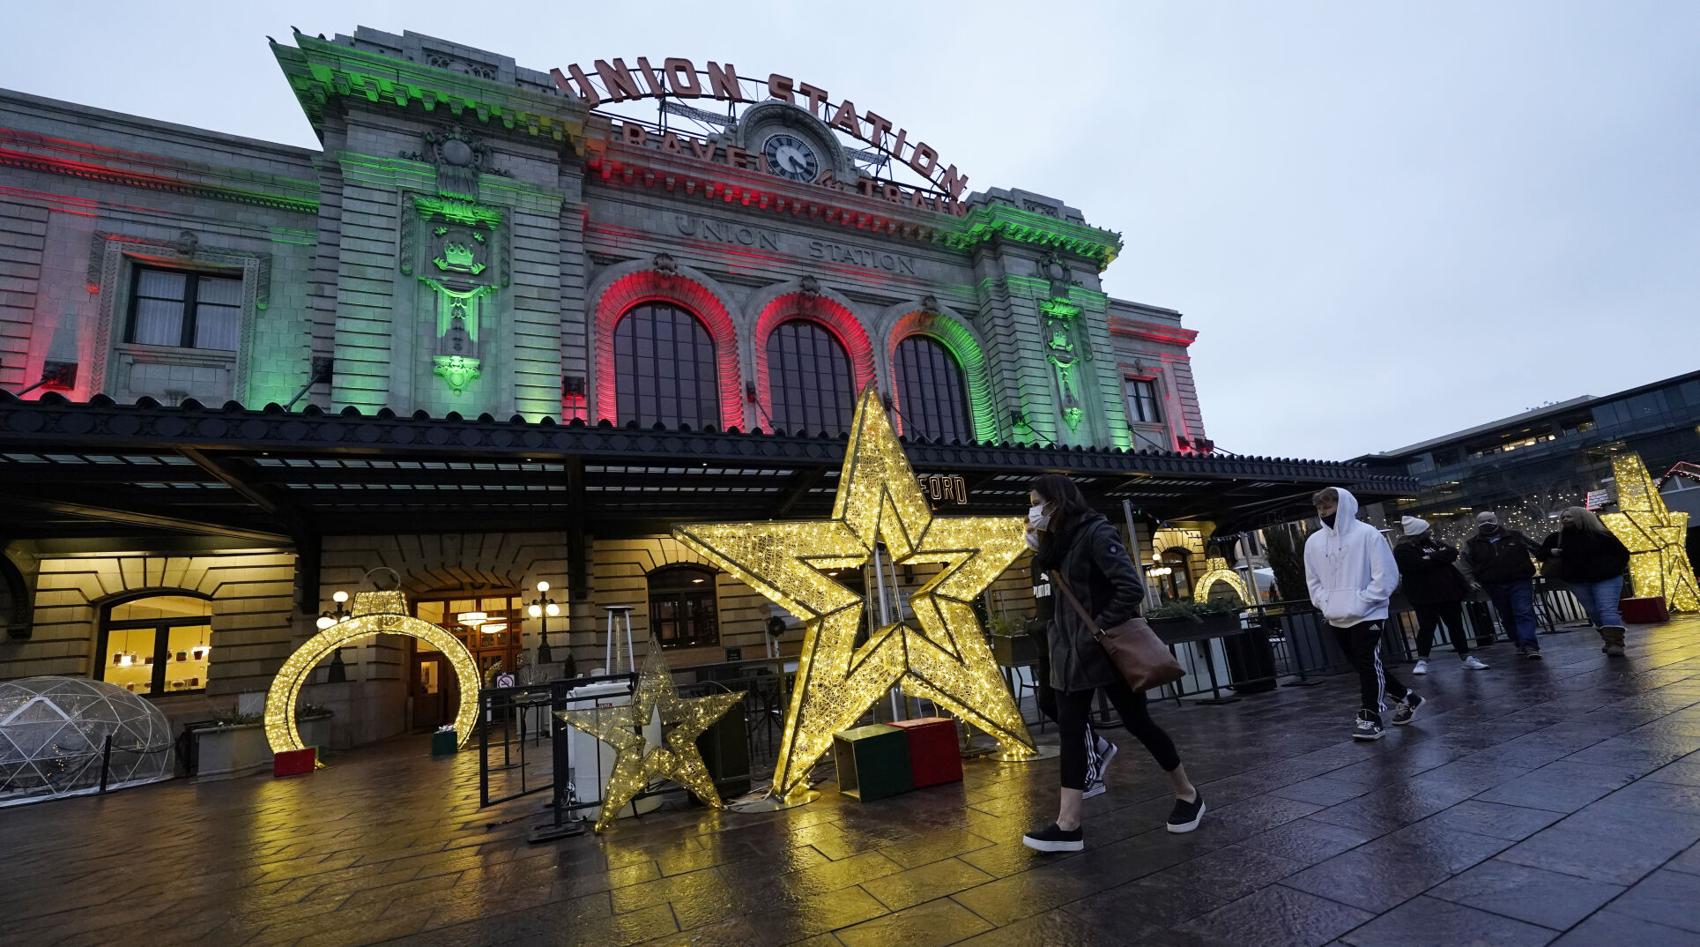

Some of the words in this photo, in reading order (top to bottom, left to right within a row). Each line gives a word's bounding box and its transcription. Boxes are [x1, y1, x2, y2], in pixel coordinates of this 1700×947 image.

[550, 56, 743, 110] UNION
[768, 73, 969, 203] STATION
[676, 216, 780, 251] UNION
[808, 241, 916, 275] STATION
